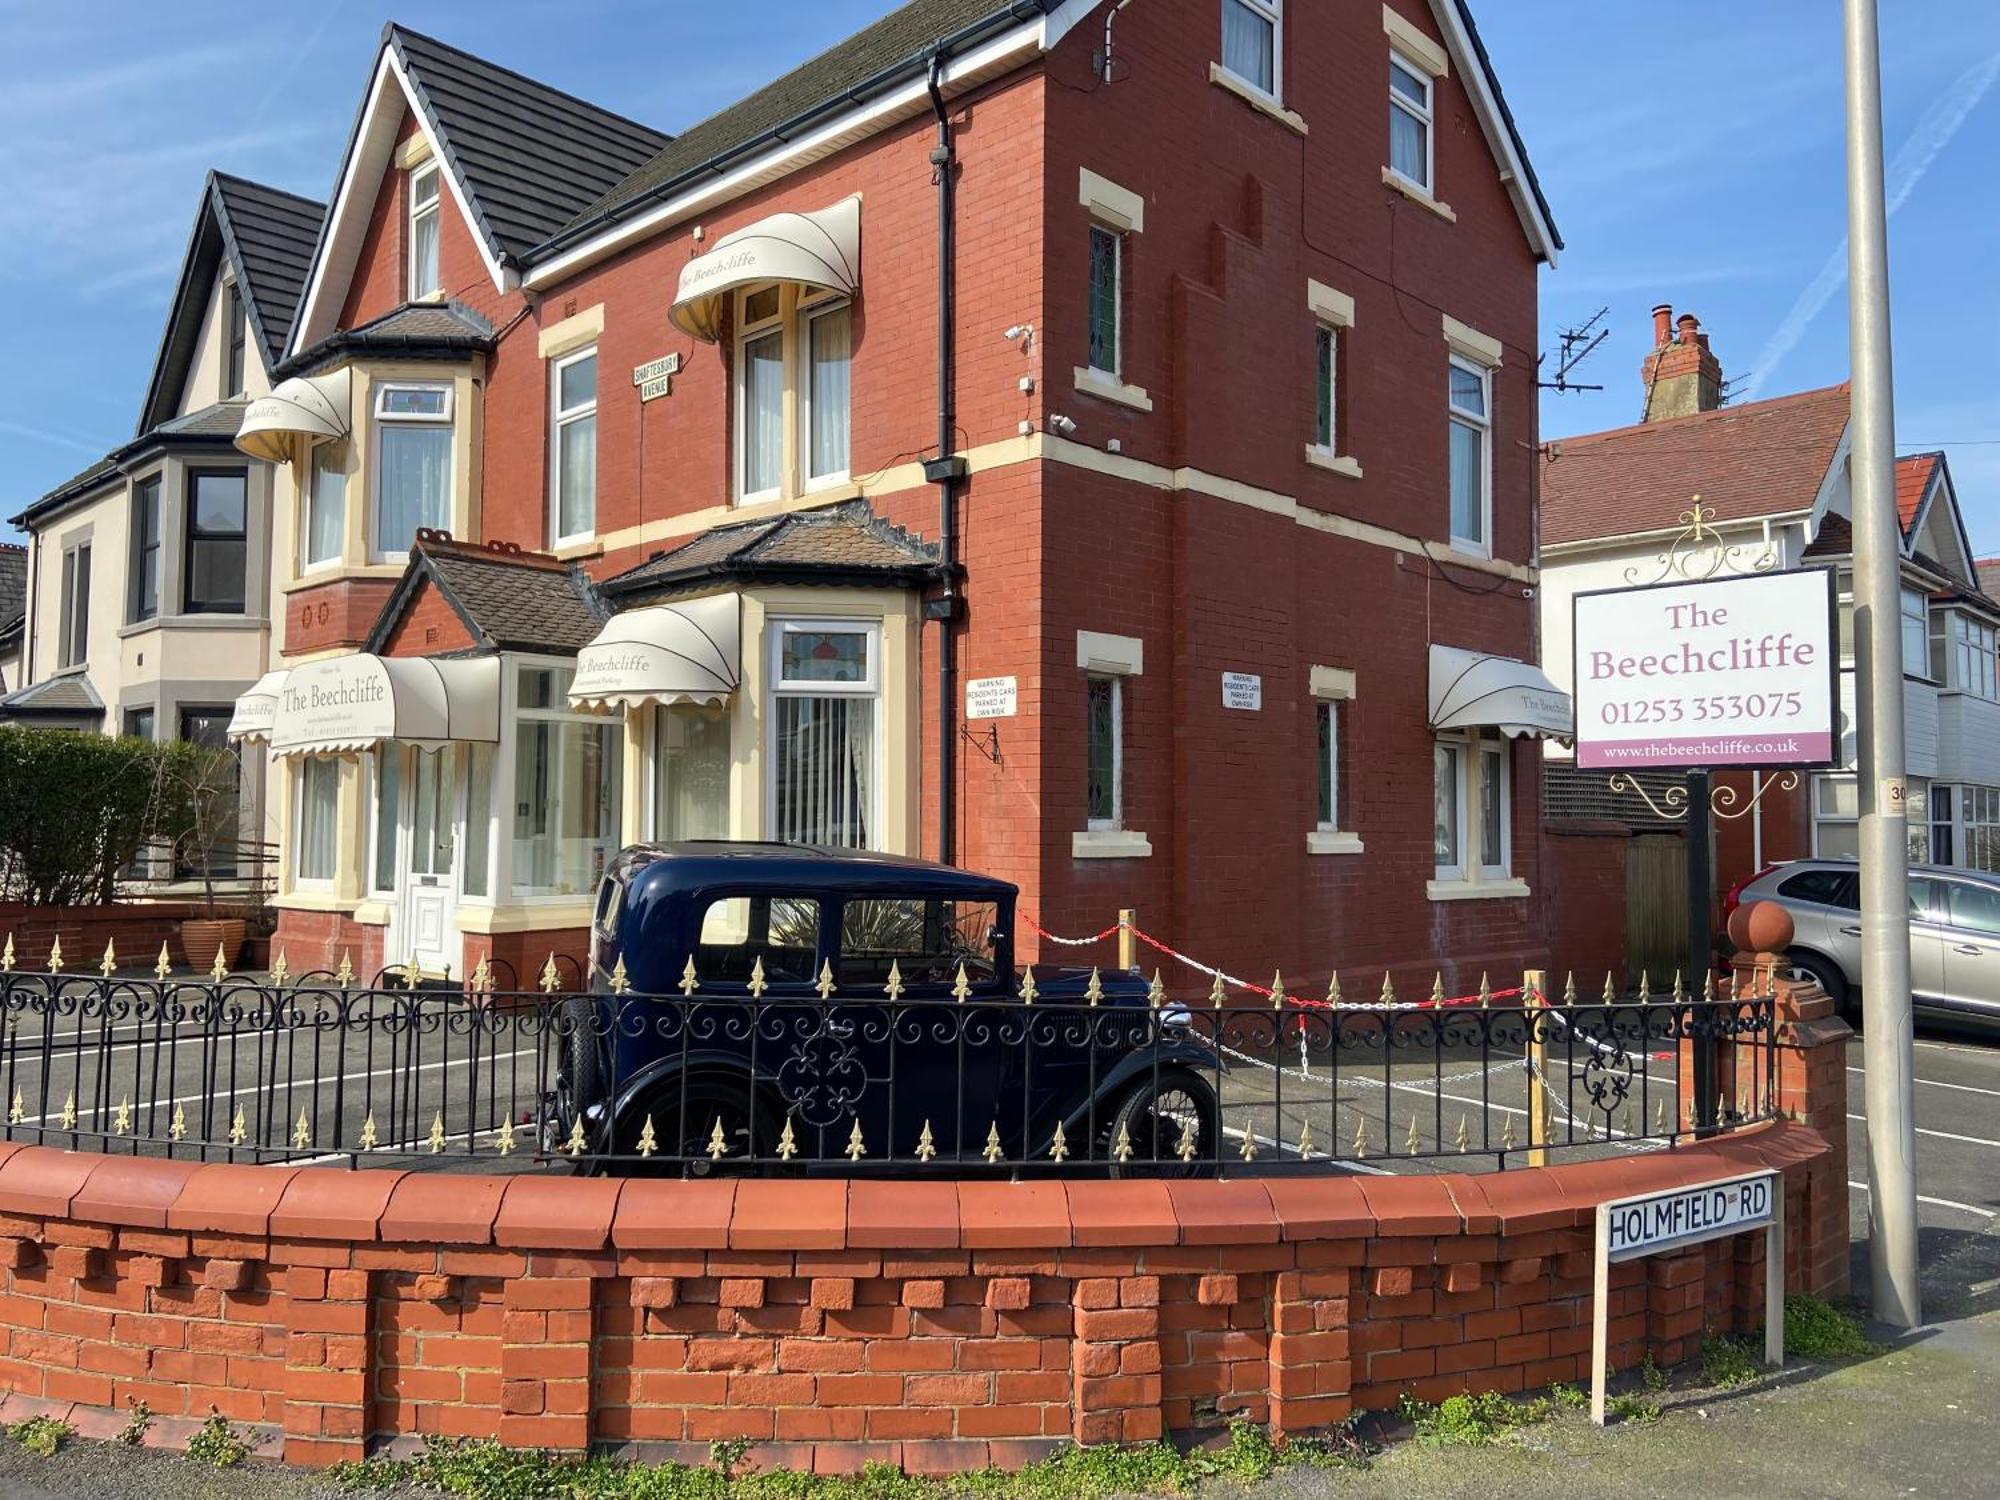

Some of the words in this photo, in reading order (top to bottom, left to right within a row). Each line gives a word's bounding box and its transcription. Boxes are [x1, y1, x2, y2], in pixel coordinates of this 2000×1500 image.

[635, 356, 677, 382] SHAFTESBURY
[643, 378, 666, 398] AVENUE
[1665, 602, 1728, 630] The
[587, 654, 650, 673] Beechcliffe
[1590, 632, 1814, 680] Beechcliffe
[283, 686, 307, 712] The
[312, 675, 384, 708] Beechcliffe
[1601, 699, 1684, 725] 01253
[1692, 691, 1801, 721] 353075
[1604, 739, 1799, 758] www.thebeechcliffe.co.uk
[1891, 786, 1906, 800] 30
[1610, 1191, 1726, 1247] HOLMFIELD
[1741, 1183, 1766, 1217] RD
